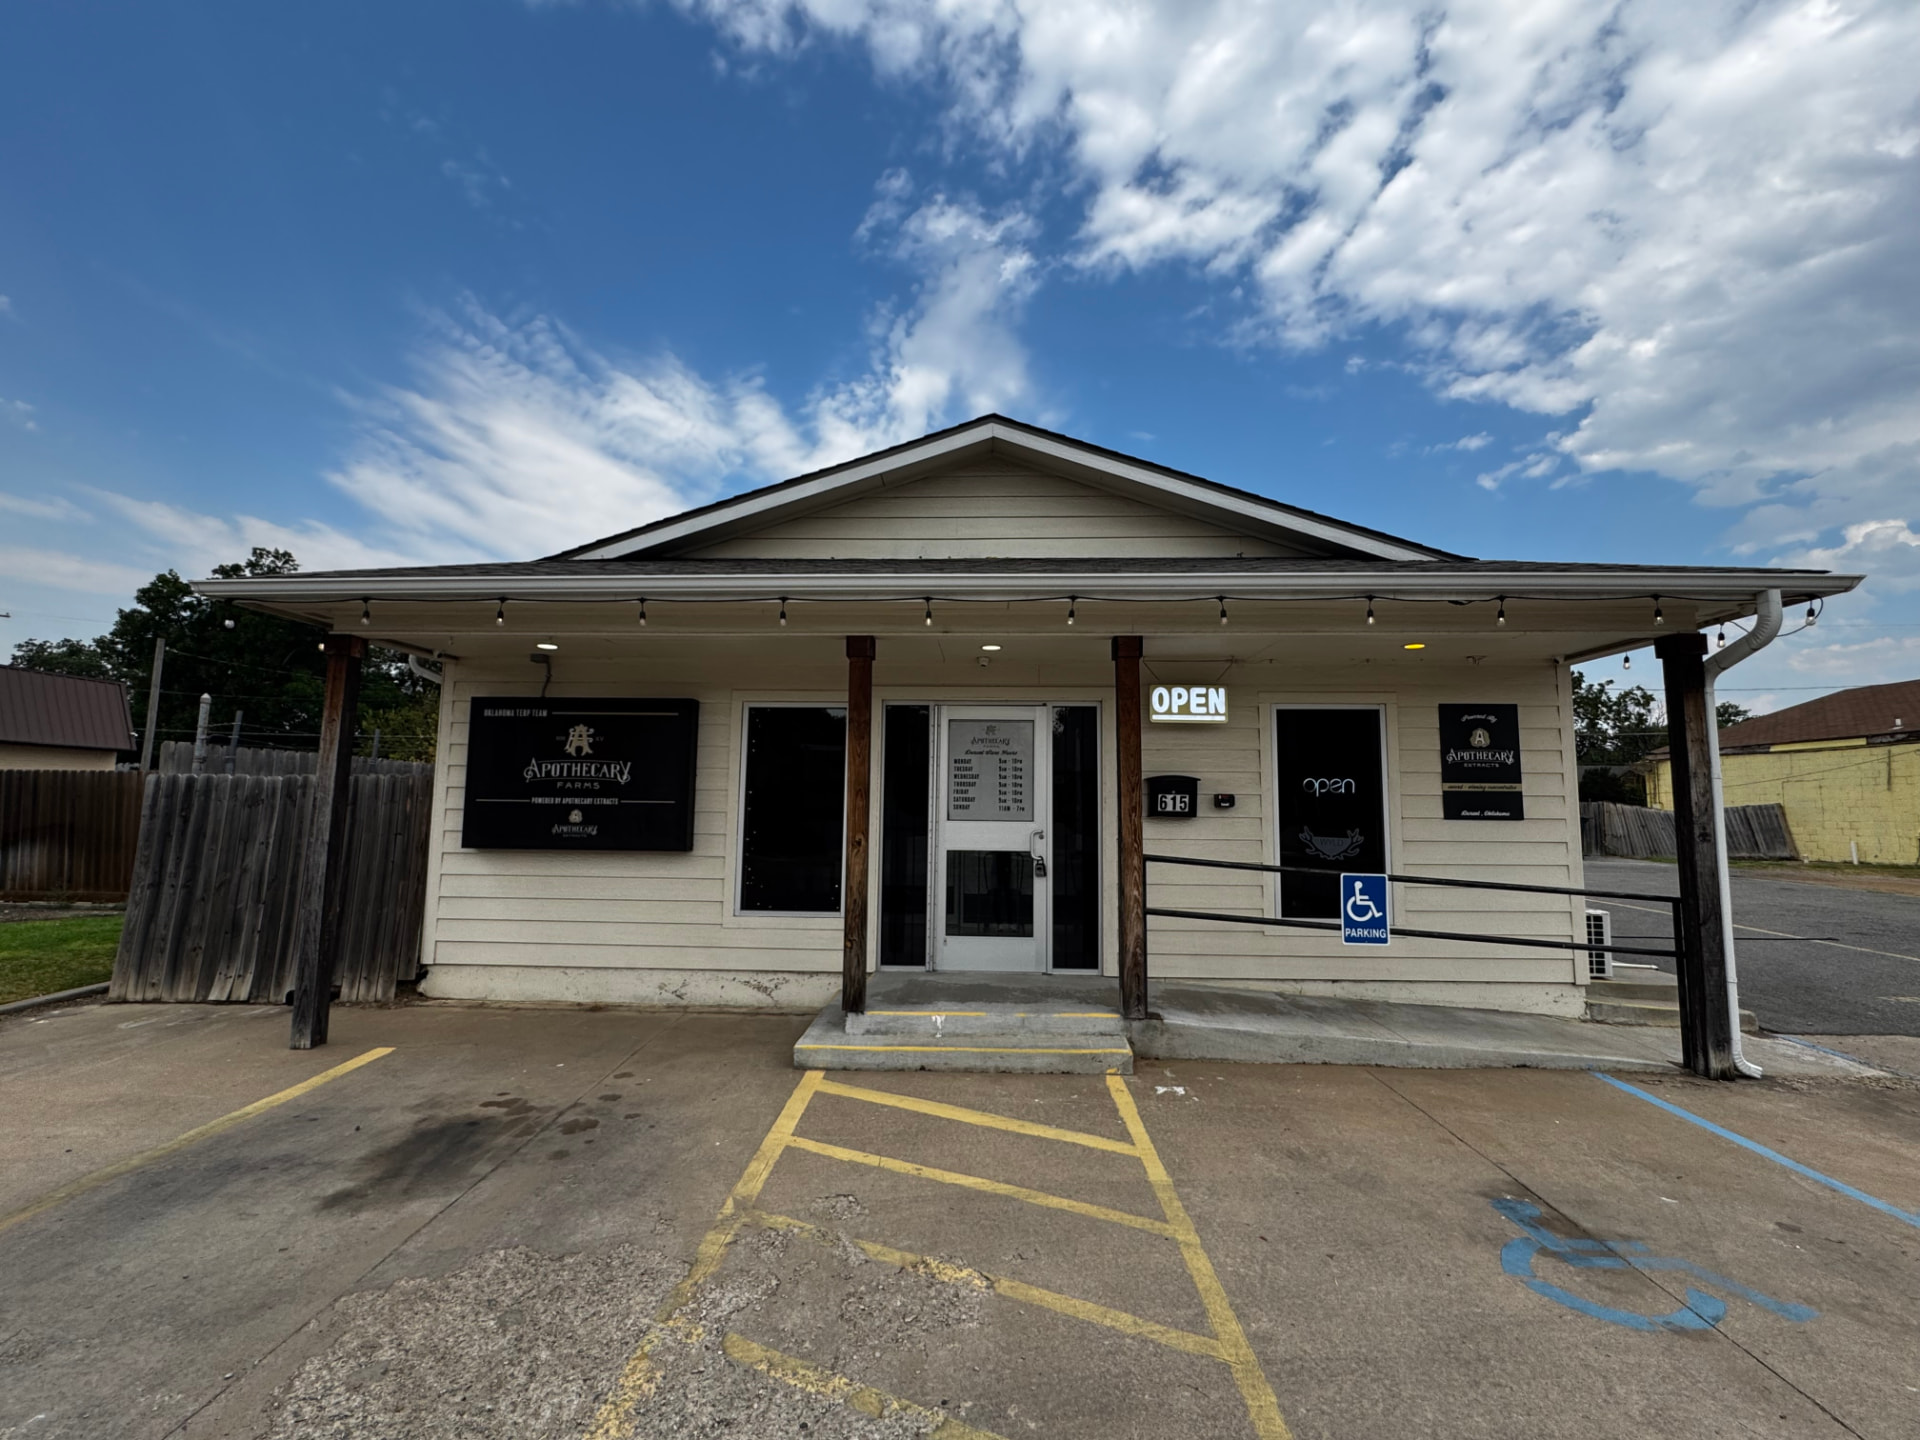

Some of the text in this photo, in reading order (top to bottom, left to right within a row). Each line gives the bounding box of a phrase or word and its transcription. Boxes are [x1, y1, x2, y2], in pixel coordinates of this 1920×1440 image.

[1152, 687, 1225, 714] OPEN
[483, 708, 515, 717] OKLAHOMA
[532, 709, 548, 717] TEAM
[1446, 748, 1514, 765] APOTHECARY
[523, 757, 632, 785] APOTHECARY
[1303, 778, 1355, 797] open
[1159, 795, 1188, 811] 615
[1345, 928, 1387, 938] PARKING
